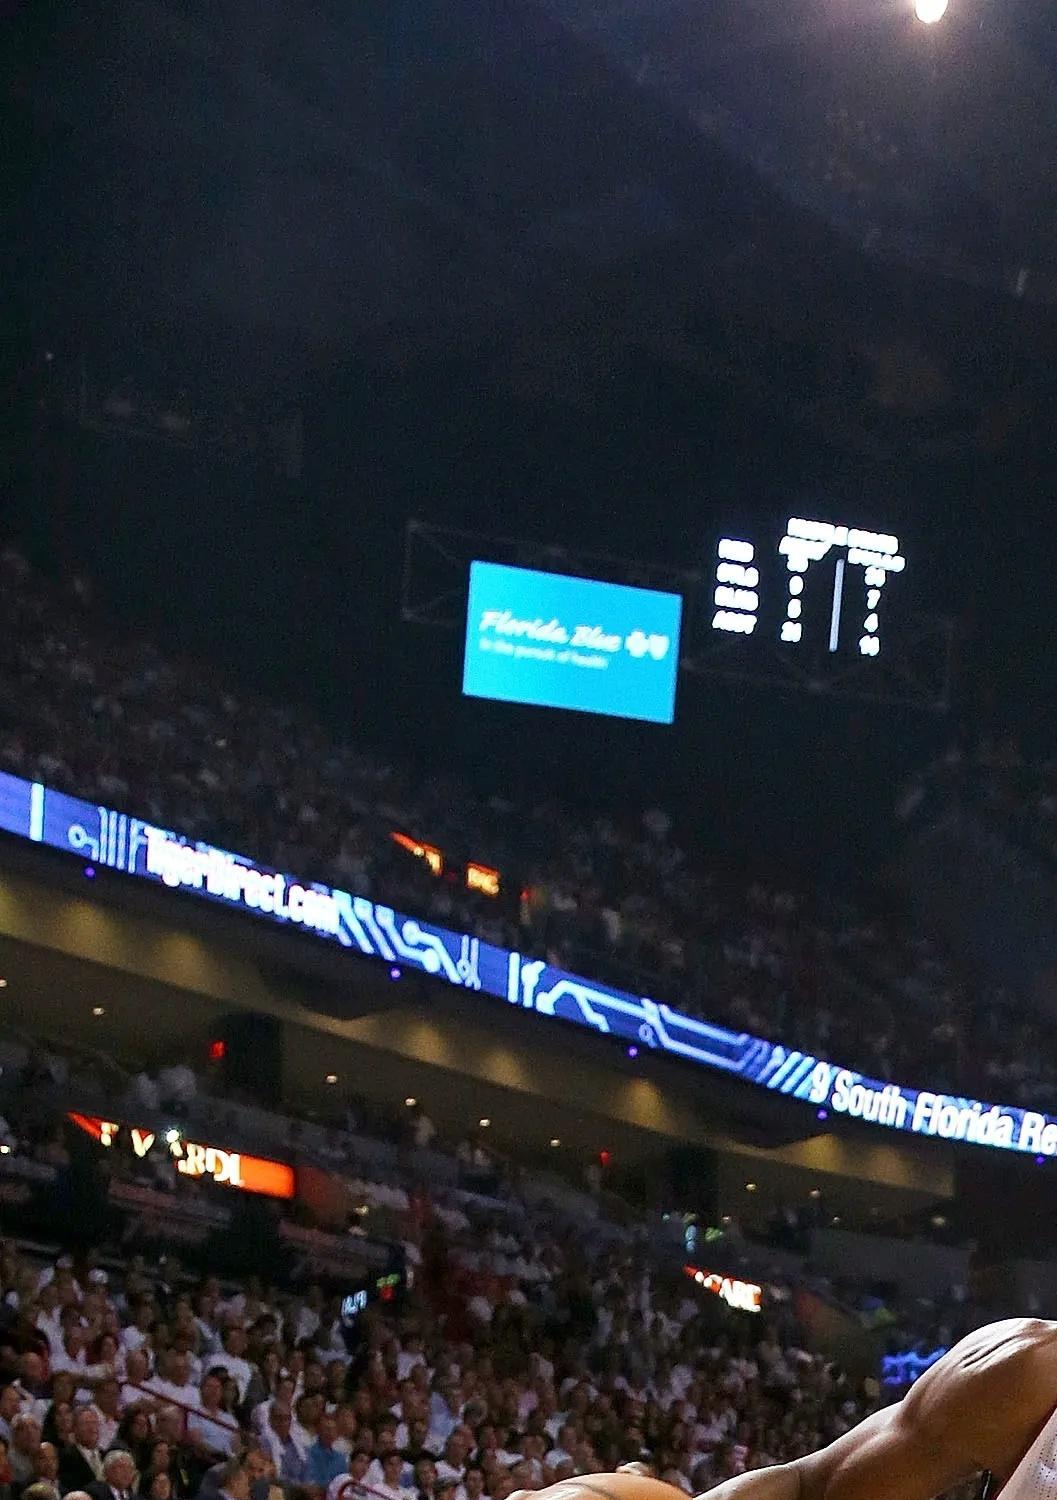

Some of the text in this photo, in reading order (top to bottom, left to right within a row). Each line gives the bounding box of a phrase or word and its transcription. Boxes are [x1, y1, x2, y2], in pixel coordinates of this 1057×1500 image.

[480, 610, 568, 645] Florida
[831, 1069, 907, 1129] South
[911, 1091, 1015, 1148] Florida
